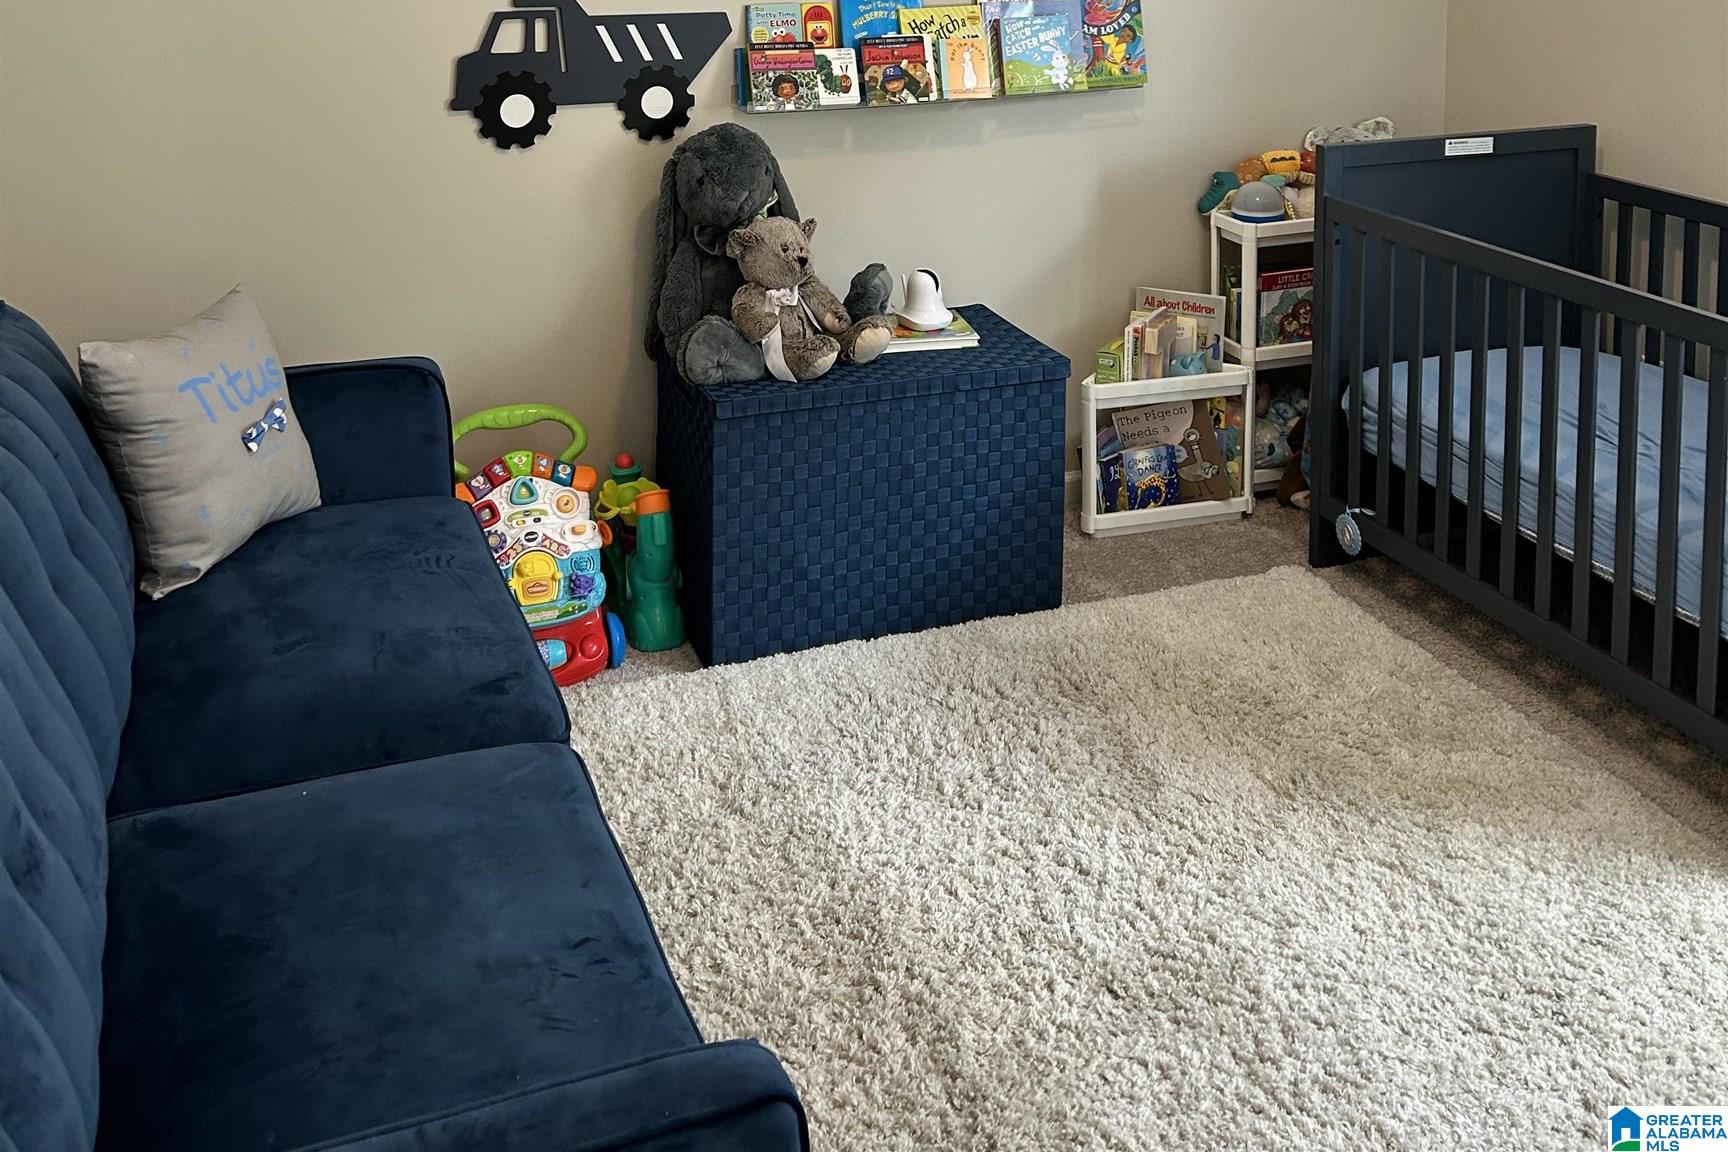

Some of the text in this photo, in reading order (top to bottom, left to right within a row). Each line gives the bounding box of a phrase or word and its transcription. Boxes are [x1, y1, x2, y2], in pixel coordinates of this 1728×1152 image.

[756, 11, 776, 19] Potty
[770, 19, 797, 28] ELMO
[852, 10, 888, 29] MULBERRY
[961, 17, 967, 28] a
[1082, 13, 1131, 35] AM LOVED
[907, 15, 935, 34] How
[1005, 21, 1024, 34] HOW
[1006, 27, 1031, 45] CATCH
[1006, 25, 1066, 57] EASTER BUNNY
[1278, 273, 1300, 284] LITTLE
[1144, 296, 1216, 315] All about Children
[177, 357, 283, 425] Titus
[1118, 406, 1187, 427] The Pigeon
[1122, 425, 1171, 443] Needs a
[1128, 454, 1156, 470] GIRAFFES
[1137, 463, 1163, 477] DANCE
